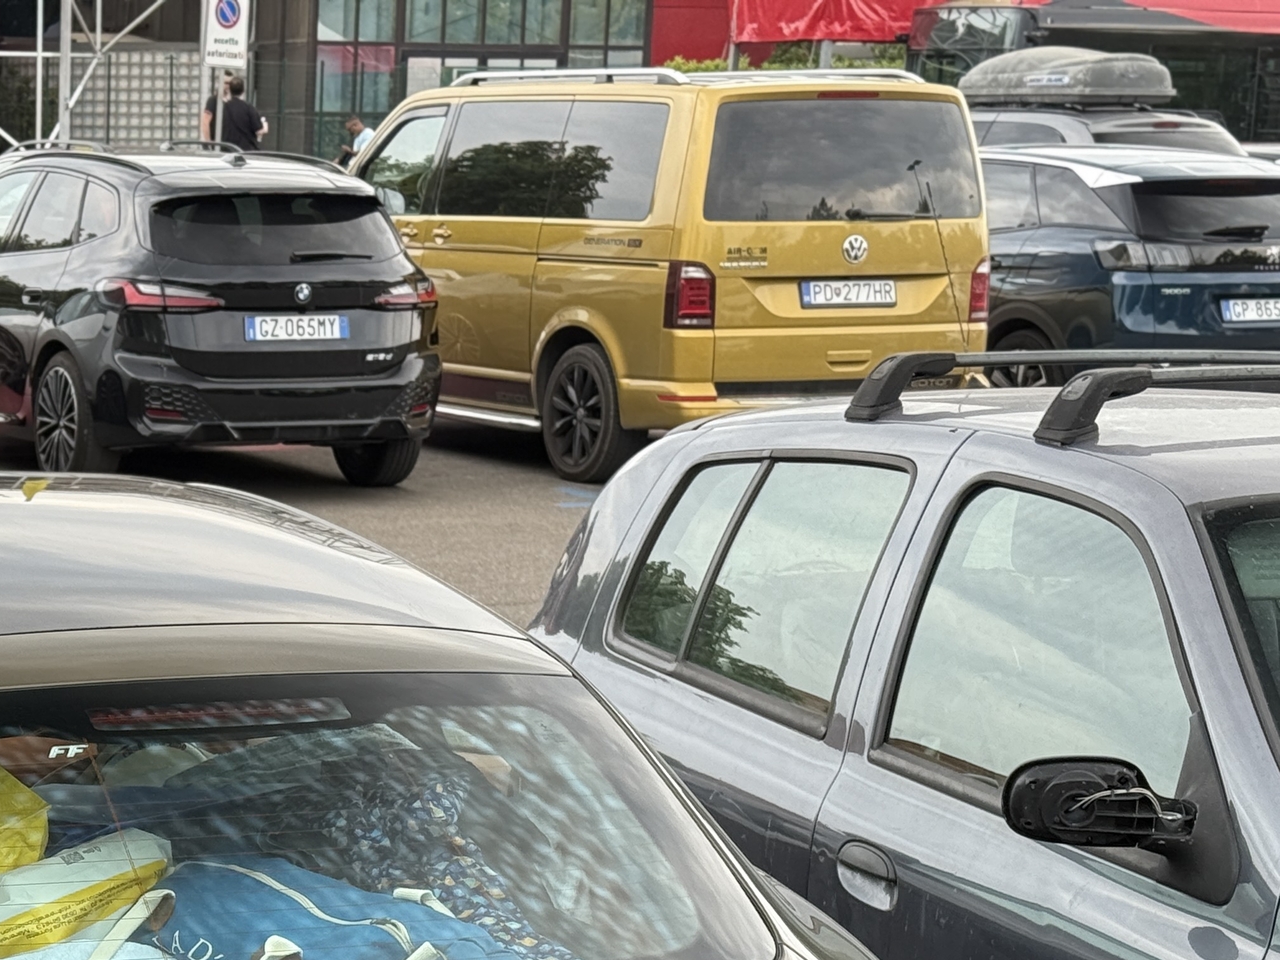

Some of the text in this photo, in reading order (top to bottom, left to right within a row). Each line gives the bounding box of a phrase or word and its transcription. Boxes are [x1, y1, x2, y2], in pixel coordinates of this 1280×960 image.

[813, 283, 893, 301] PD 277HR
[260, 318, 336, 337] GZ 065MY
[48, 744, 89, 758] FF
